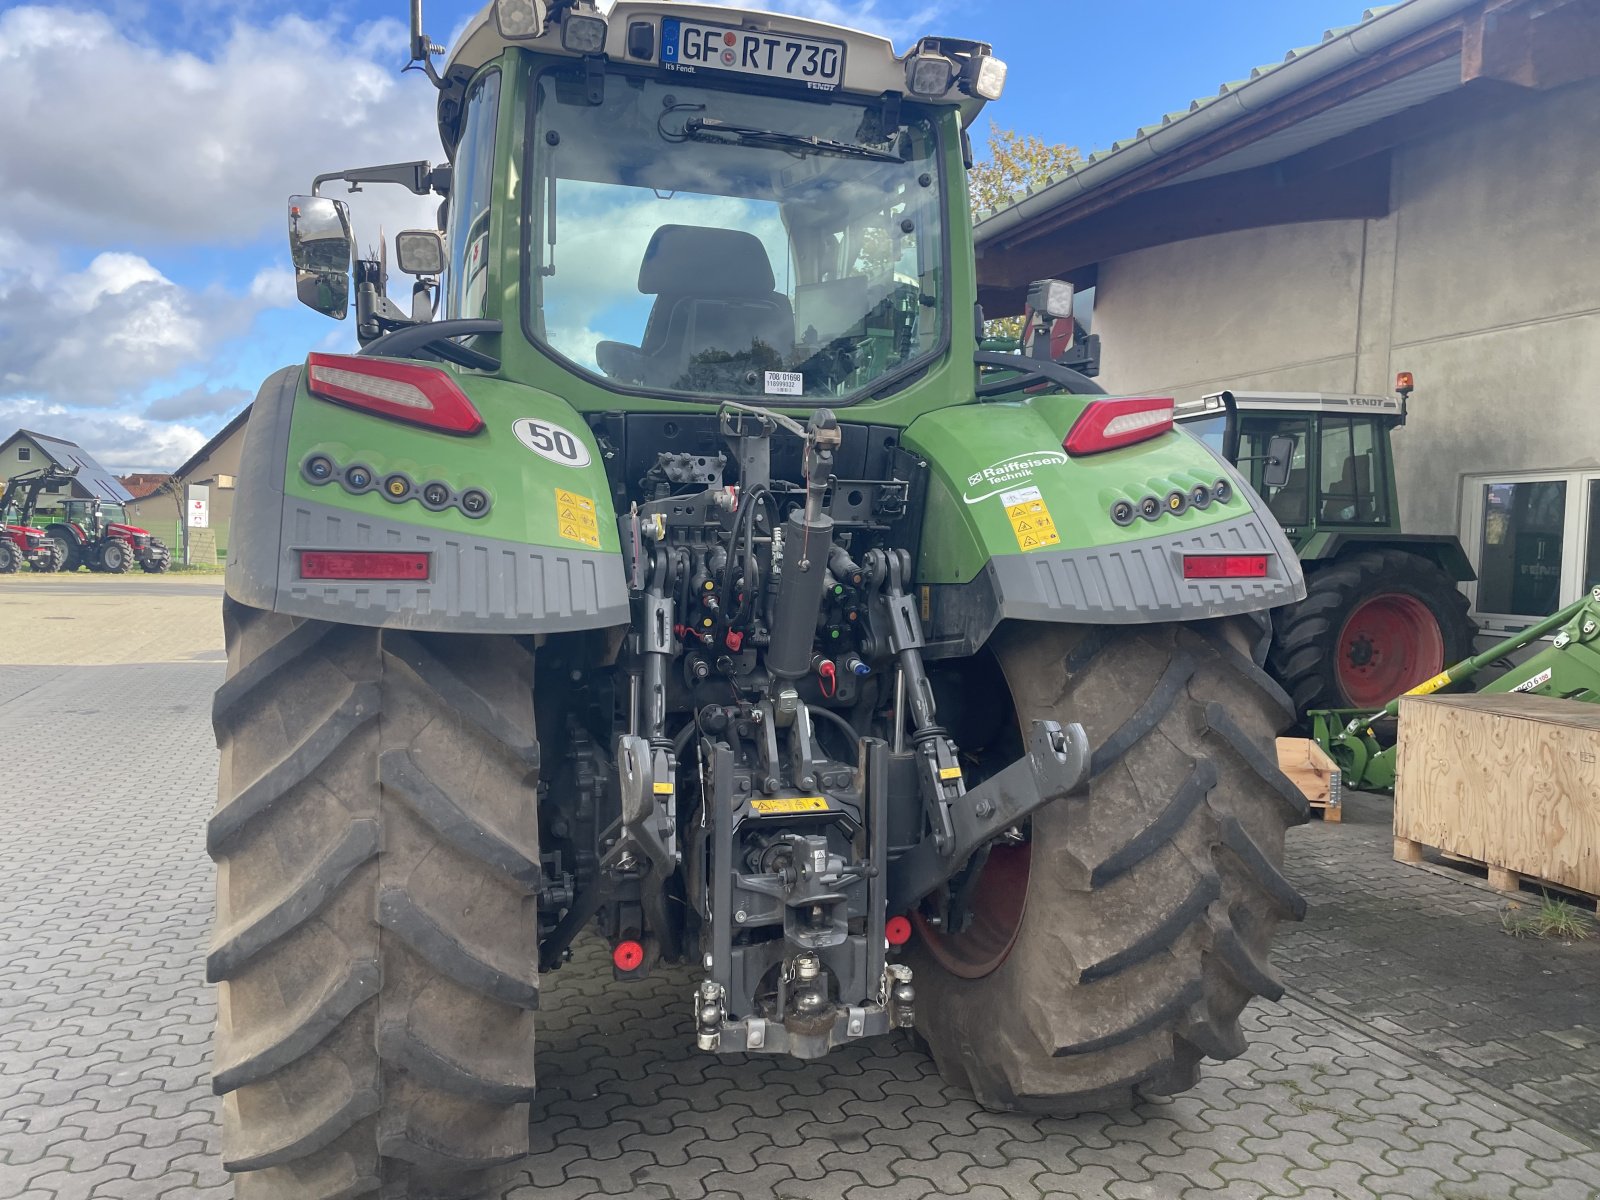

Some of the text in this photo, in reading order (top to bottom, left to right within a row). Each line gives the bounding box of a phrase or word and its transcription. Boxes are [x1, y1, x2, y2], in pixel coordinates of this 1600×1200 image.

[666, 46, 674, 55] D
[683, 28, 722, 62] GF
[807, 81, 836, 91] FENDT
[1348, 398, 1384, 407] FENDT
[528, 422, 577, 460] 50
[982, 456, 1062, 479] Raiffeisen
[986, 469, 1034, 485] Technik
[1533, 677, 1539, 685] 6
